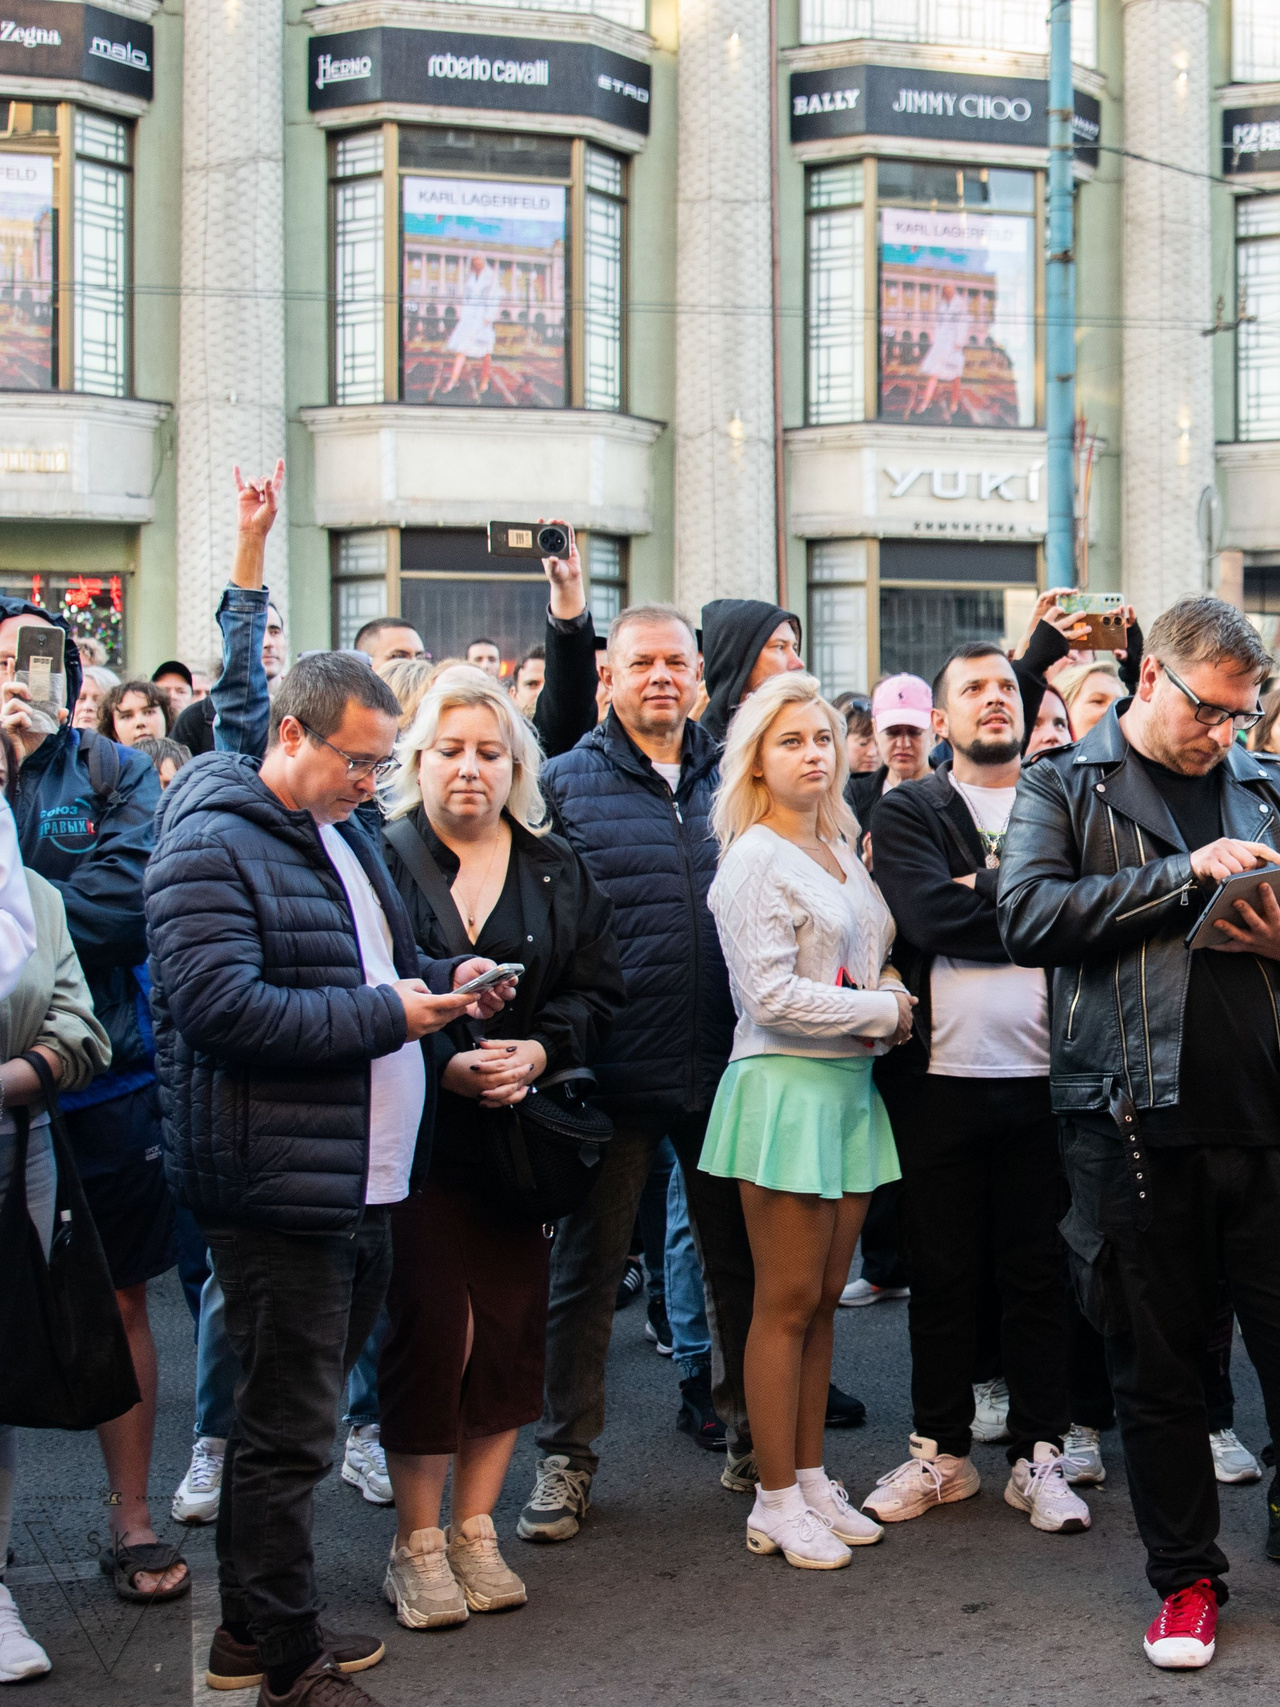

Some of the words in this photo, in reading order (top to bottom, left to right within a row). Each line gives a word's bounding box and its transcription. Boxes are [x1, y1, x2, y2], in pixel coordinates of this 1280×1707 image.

[0, 20, 62, 48] Zegna
[89, 36, 150, 71] malo
[427, 53, 492, 81] roberto
[492, 59, 549, 86] cavalli
[793, 89, 860, 115] BALLY
[892, 88, 957, 116] JIMMY
[959, 93, 1032, 122] CHOO
[418, 189, 459, 206] KARL
[461, 193, 550, 211] LAGERFELD
